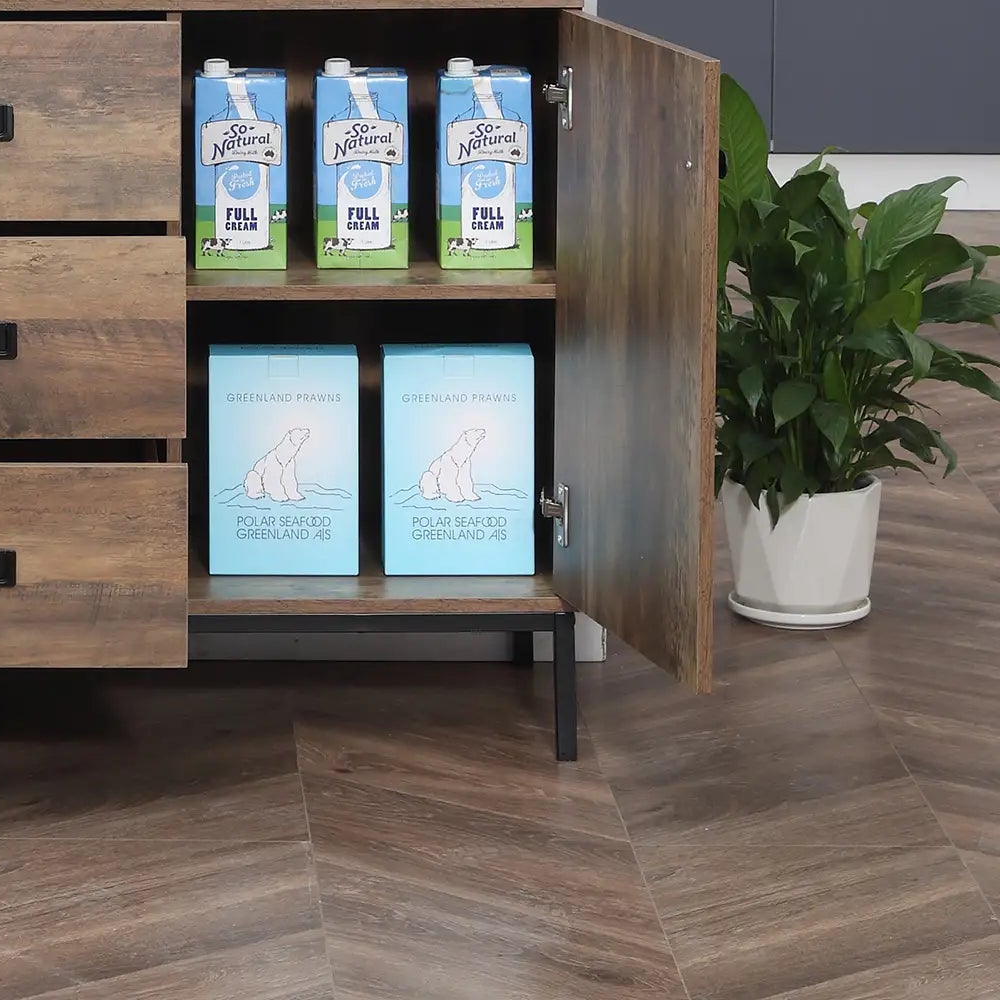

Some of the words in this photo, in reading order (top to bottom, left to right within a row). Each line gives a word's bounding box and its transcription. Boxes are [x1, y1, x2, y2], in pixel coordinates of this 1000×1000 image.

[212, 133, 270, 160] Natural
[333, 132, 392, 160] Natural
[457, 131, 516, 160] Natural
[226, 207, 258, 221] FULL
[347, 207, 380, 221] FULL
[472, 206, 504, 220] FULL
[225, 221, 258, 231] CREAM
[347, 221, 380, 231] CREAM
[471, 221, 504, 231] CREAM
[226, 393, 292, 403] GREENLAND
[296, 393, 341, 403] PRAWNS
[401, 393, 468, 403] GREENLAND
[472, 393, 517, 403] PRAWNS
[236, 515, 275, 527] POLAR
[279, 515, 331, 527] SEAFOOD
[412, 516, 451, 528] POLAR
[455, 516, 507, 528] SEAFOOD
[236, 528, 309, 540] GREENLAND
[411, 528, 485, 541] GREENLAND
